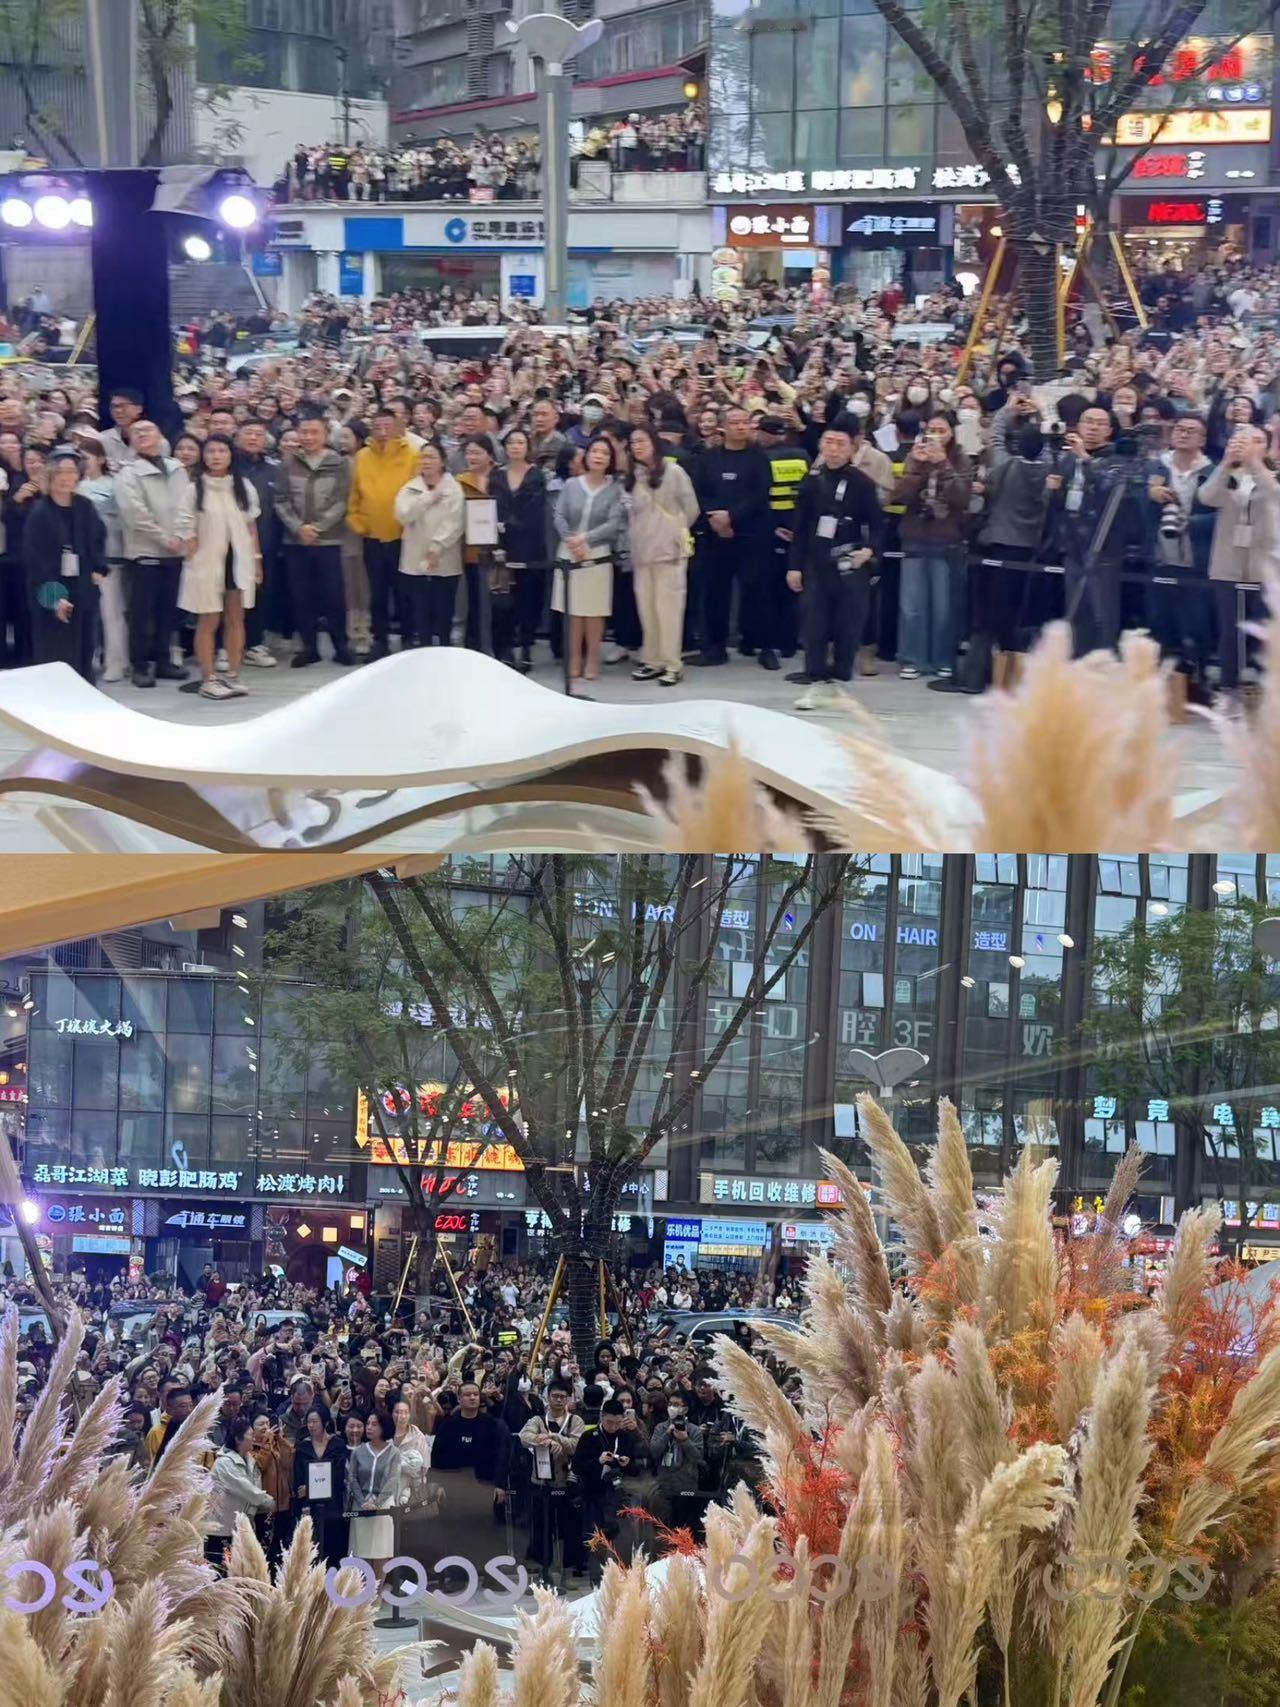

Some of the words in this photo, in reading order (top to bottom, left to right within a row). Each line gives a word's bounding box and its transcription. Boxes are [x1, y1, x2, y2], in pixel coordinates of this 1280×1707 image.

[850, 922, 877, 942] ON
[896, 926, 938, 947] HAIR
[974, 931, 1008, 951] 造型
[893, 1018, 934, 1048] 3F
[33, 1164, 129, 1187] 磊哥江湖菜
[138, 1169, 239, 1191] 晓彭肥肠鸡
[256, 1173, 336, 1194] 松渡烤肉
[713, 1180, 816, 1203] 手机回收维修
